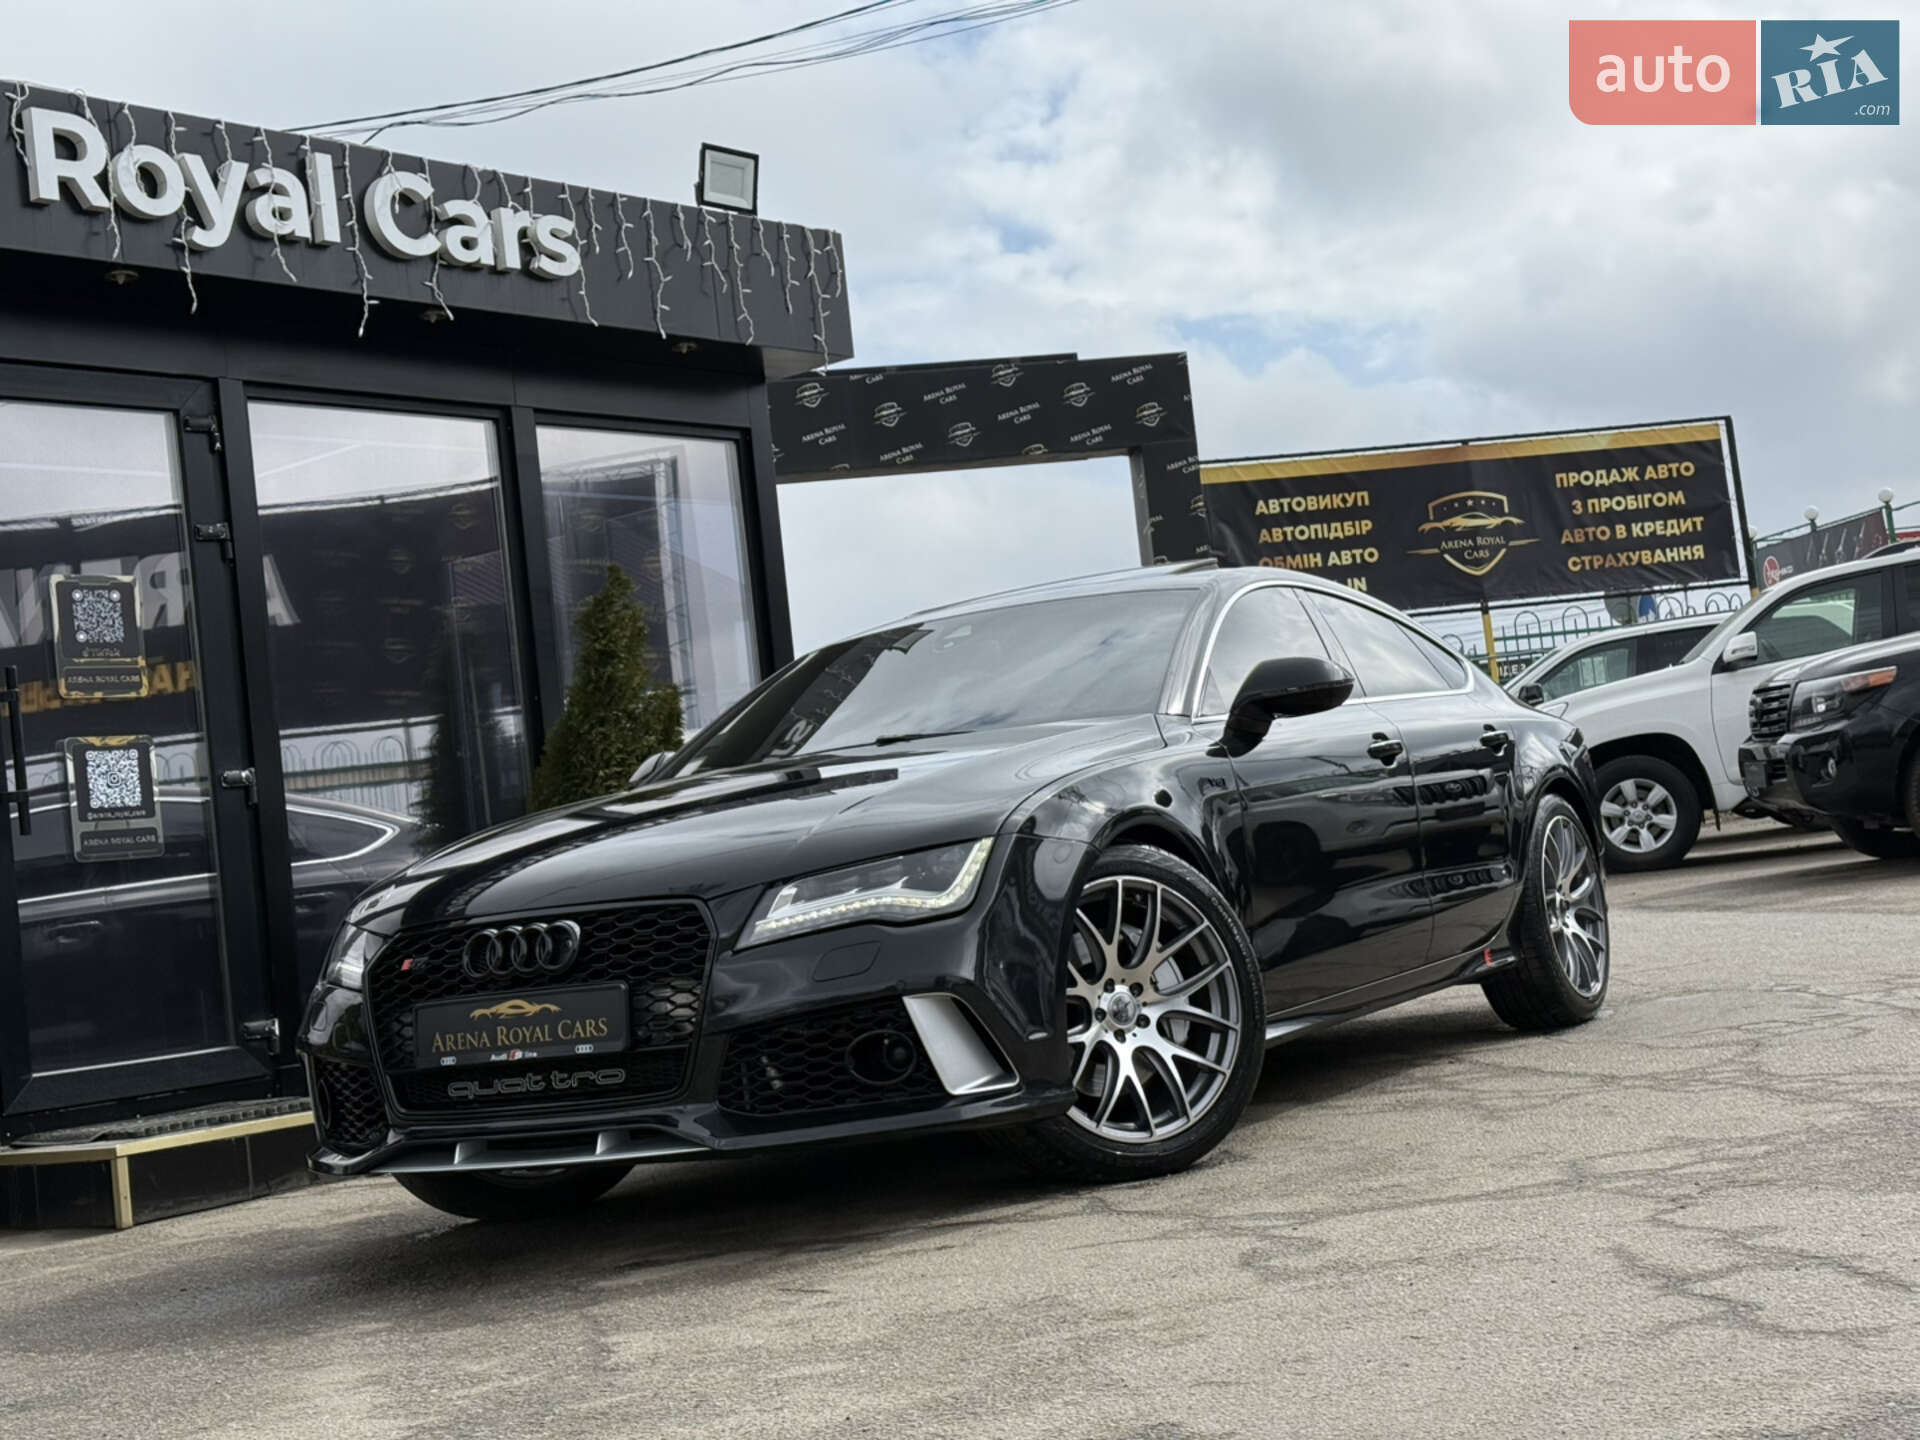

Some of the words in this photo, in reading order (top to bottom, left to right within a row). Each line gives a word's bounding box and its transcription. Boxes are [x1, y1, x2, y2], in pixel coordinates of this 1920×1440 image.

[21, 106, 341, 251] Royal
[365, 171, 582, 281] Cars
[1555, 466, 1640, 489] ПРОДАЖ
[1644, 461, 1695, 481] АВТО
[1255, 491, 1370, 516] АВТОВИКУП
[1588, 490, 1686, 514] ПРОБІГОМ
[1258, 520, 1373, 544] АВТОПІДБІР
[1441, 538, 1475, 549] ARENA
[1476, 536, 1506, 545] ROYAL
[1561, 526, 1611, 544] АВТО
[1615, 524, 1627, 539] В
[1631, 516, 1704, 538] КРЕДИТ
[1259, 552, 1322, 569] ОБМІН
[1327, 547, 1379, 567] АВТО
[1464, 549, 1490, 560] CARS
[1568, 544, 1705, 572] СТРАХУВАННЯ
[432, 1031, 491, 1053] ARENA
[496, 1024, 552, 1047] ROYAL
[557, 1017, 608, 1041] CARS
